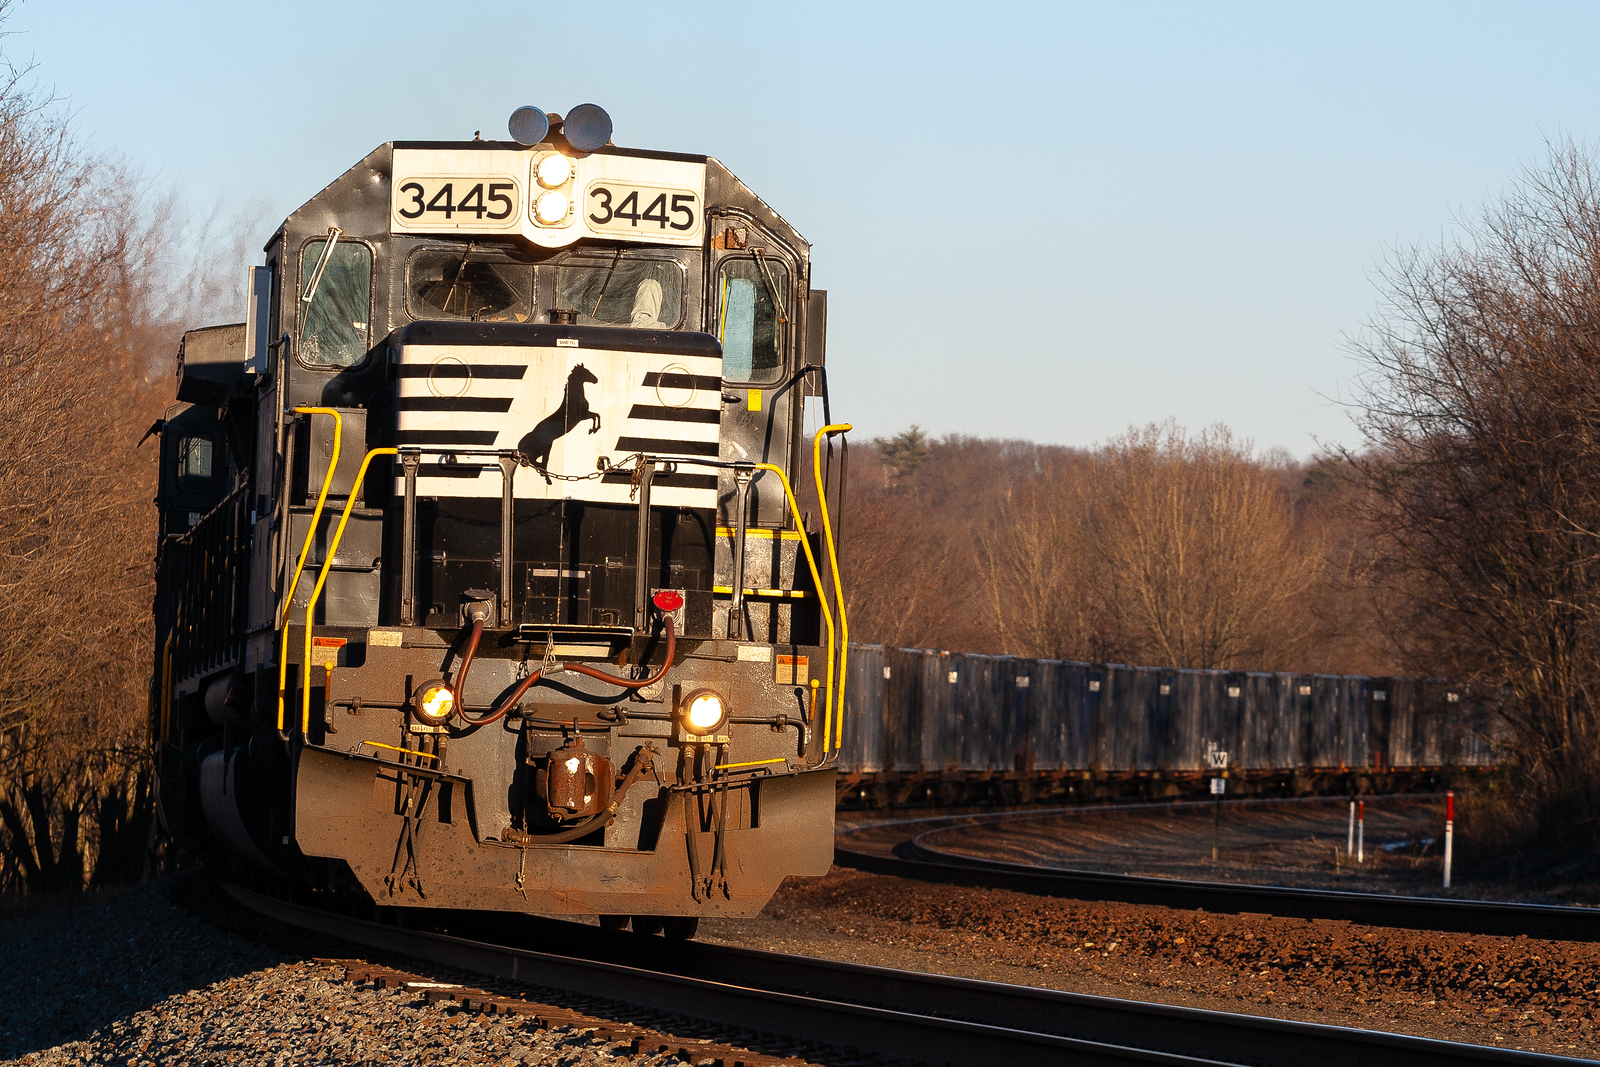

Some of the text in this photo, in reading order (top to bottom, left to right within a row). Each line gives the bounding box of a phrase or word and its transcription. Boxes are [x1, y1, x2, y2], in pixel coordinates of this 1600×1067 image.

[399, 182, 513, 220] 3445
[589, 187, 695, 231] 3445
[1213, 754, 1226, 765] W
